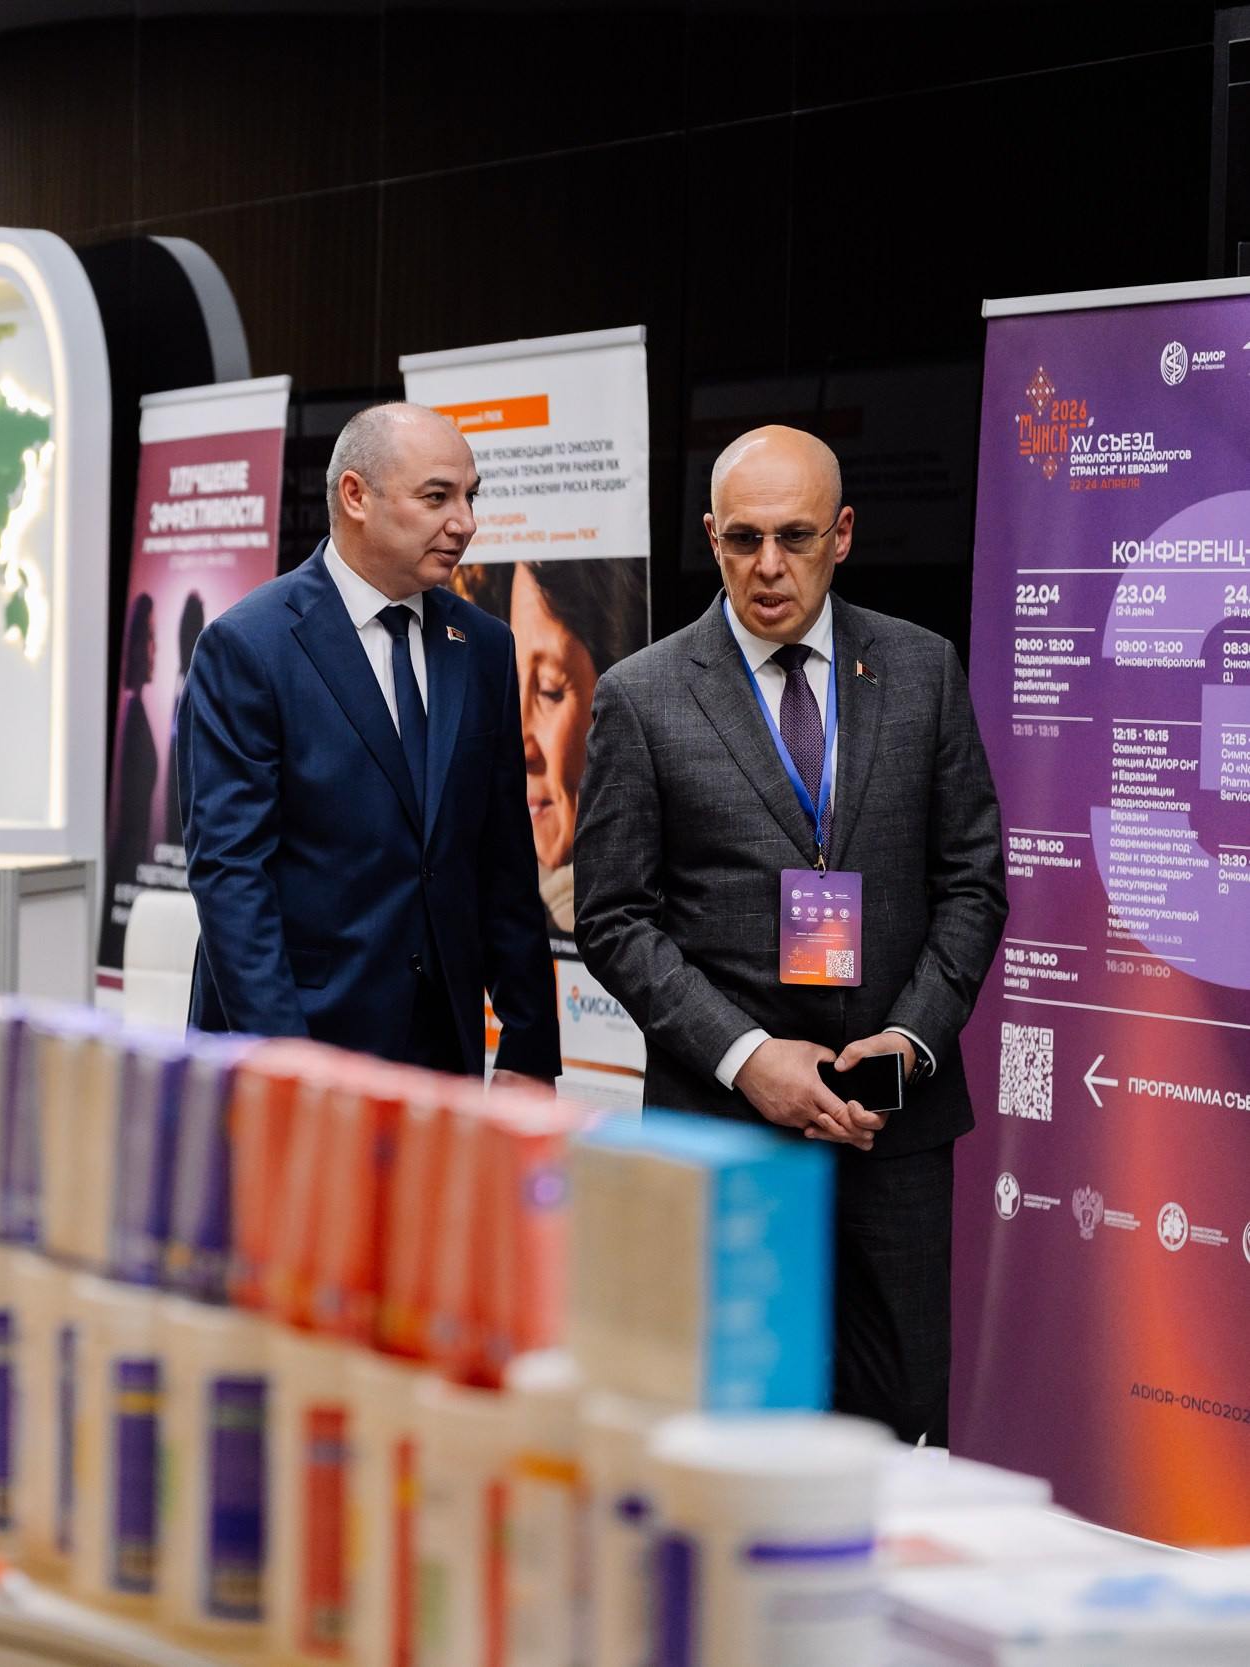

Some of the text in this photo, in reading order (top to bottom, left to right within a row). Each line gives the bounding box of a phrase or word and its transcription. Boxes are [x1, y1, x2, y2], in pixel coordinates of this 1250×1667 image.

[1192, 350, 1226, 363] АДИОР
[1051, 400, 1087, 422] 2026
[1070, 432, 1154, 453] XV СЪЕЗД
[1070, 450, 1192, 464] ОНКОЛОГОВ И РАДИОЛОГОВ
[1070, 463, 1168, 476] СТРАН СНГ И ЕВРАЗИИ
[1100, 478, 1140, 489] АПРЕЛЯ
[1016, 584, 1060, 604] 22.04
[1116, 584, 1166, 604] 23.04
[1132, 607, 1154, 617] день)
[1015, 638, 1043, 652] 09:00
[1048, 639, 1074, 652] 12:00
[1115, 640, 1146, 653] 09:00
[1154, 640, 1182, 653] 12:00
[1014, 653, 1090, 666] Поддерживающая
[1115, 656, 1206, 669] Онковертебрология
[1014, 667, 1045, 679] терапия
[1014, 680, 1069, 693] реабилитация
[1019, 694, 1060, 704] онкологии
[1012, 724, 1033, 736] 12:15
[1112, 728, 1136, 742] 12:15
[1144, 728, 1169, 742] 16:15
[1221, 733, 1246, 746] 12:15
[1112, 742, 1167, 756] Совместная
[1112, 758, 1199, 771] секция АДИОР СНГ
[1112, 771, 1157, 783] и Евразии
[1112, 784, 1175, 798] и Ассоциации
[1111, 798, 1191, 812] кардиоонкологов
[1111, 810, 1148, 822] Евразии
[1110, 838, 1171, 852] современные
[1008, 850, 1040, 864] Опухоли
[1041, 856, 1072, 868] головы
[1110, 853, 1209, 868] ходы к профилактике
[1218, 853, 1247, 867] 13:30
[1109, 865, 1115, 874] и
[1116, 866, 1156, 878] лечению
[1109, 878, 1168, 892] васкулярных
[1218, 883, 1228, 895] (2)
[1108, 892, 1166, 905] осложнений
[1108, 905, 1199, 922] противоопухолевой
[1108, 918, 1149, 931] терапии»
[1004, 962, 1036, 977] Опухоли
[1037, 969, 1070, 981] головы
[1106, 960, 1134, 974] 16:30
[1141, 963, 1171, 978] 19:00
[1128, 1076, 1222, 1106] ПРОГРАММА
